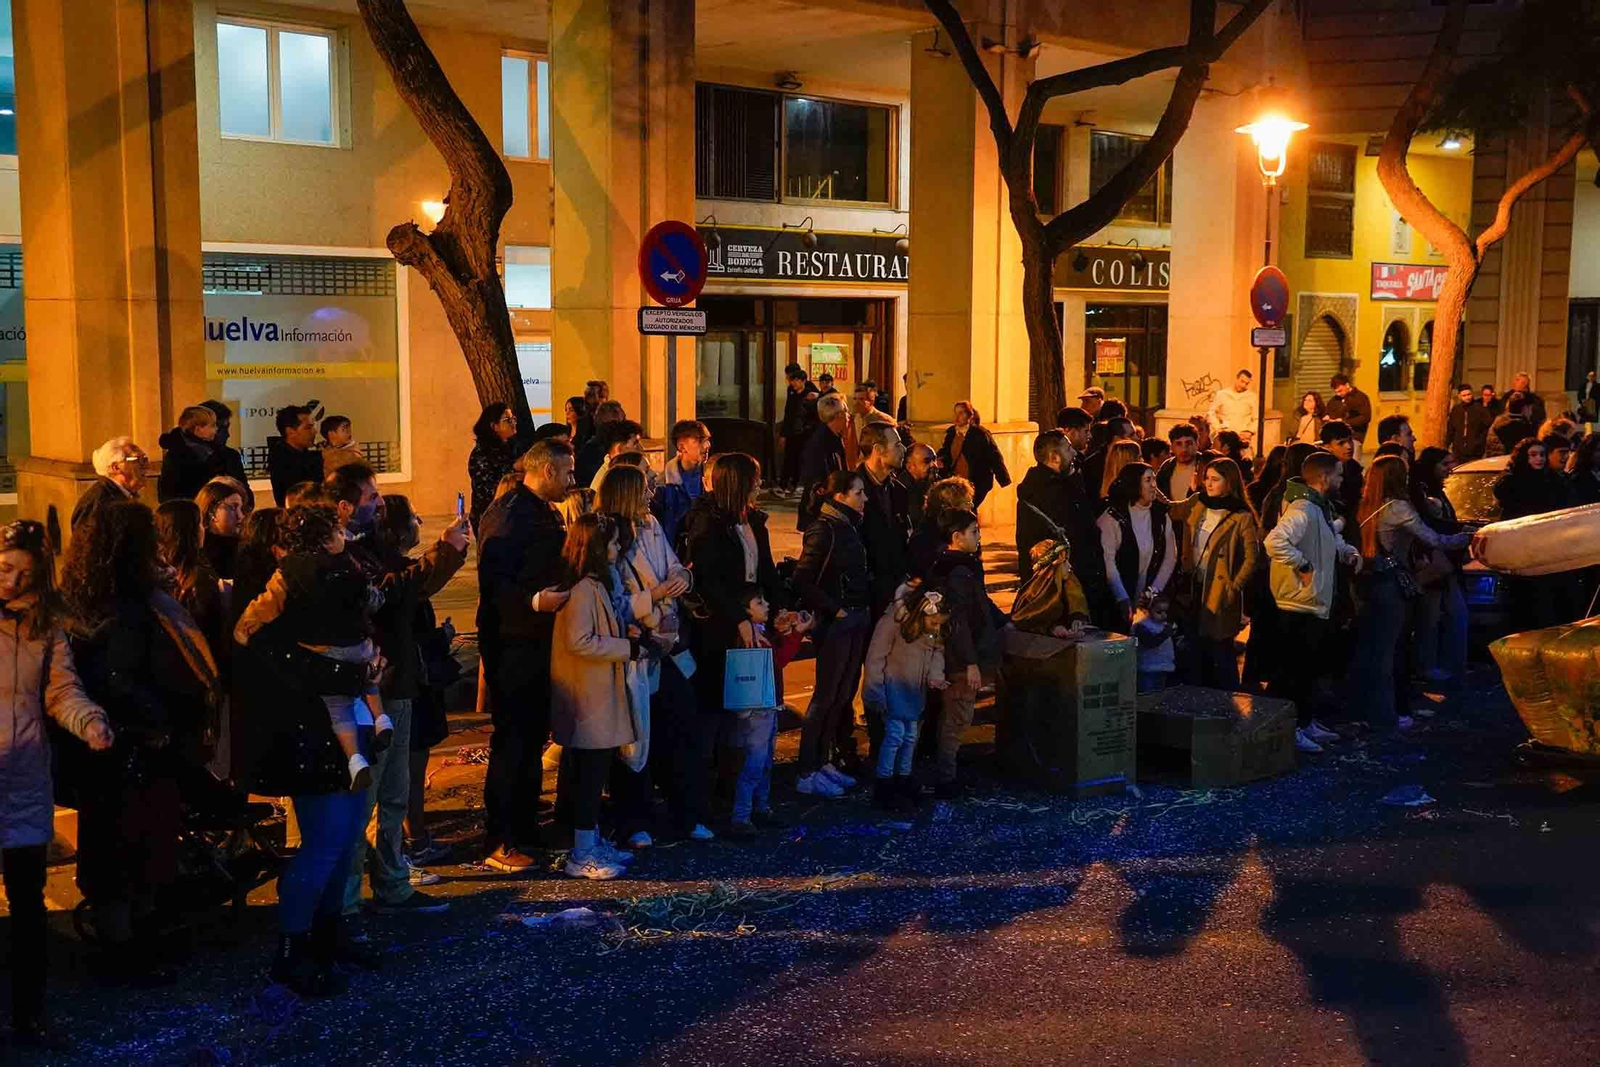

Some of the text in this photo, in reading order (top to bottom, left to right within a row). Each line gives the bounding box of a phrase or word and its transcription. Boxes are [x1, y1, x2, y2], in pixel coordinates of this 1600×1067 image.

[727, 244, 764, 252] CERVEZA
[727, 257, 764, 266] BODEGA
[777, 250, 909, 279] RESTAURA
[204, 316, 353, 342] uelva Información
[216, 366, 326, 375] www.huelvainformacion.es
